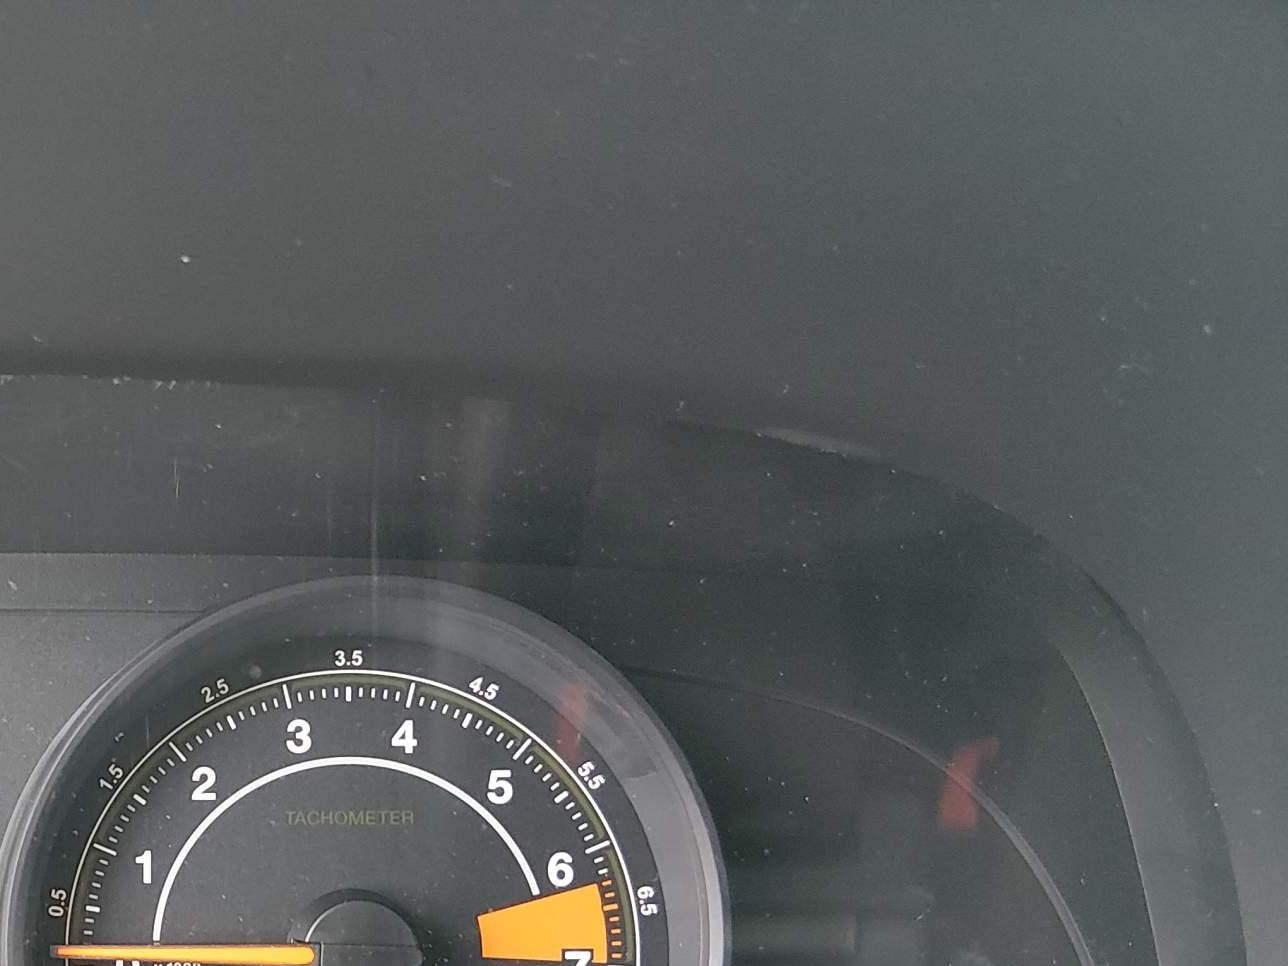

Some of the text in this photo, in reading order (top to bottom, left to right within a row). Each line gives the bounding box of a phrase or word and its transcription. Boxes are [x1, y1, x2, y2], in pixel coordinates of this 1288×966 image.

[334, 649, 363, 667] 3.5
[201, 678, 230, 704] 2.5
[468, 676, 500, 701] 4.5
[286, 718, 312, 754] 3
[391, 719, 418, 754] 4
[99, 764, 124, 791] 1.5
[191, 766, 217, 801] 2
[486, 769, 513, 805] 5
[576, 761, 606, 791] 5.5
[285, 810, 414, 826] TACHOMETER
[135, 850, 152, 884] 1
[547, 851, 574, 888] 6
[48, 889, 68, 917] 0.5
[636, 885, 658, 916] 6.5
